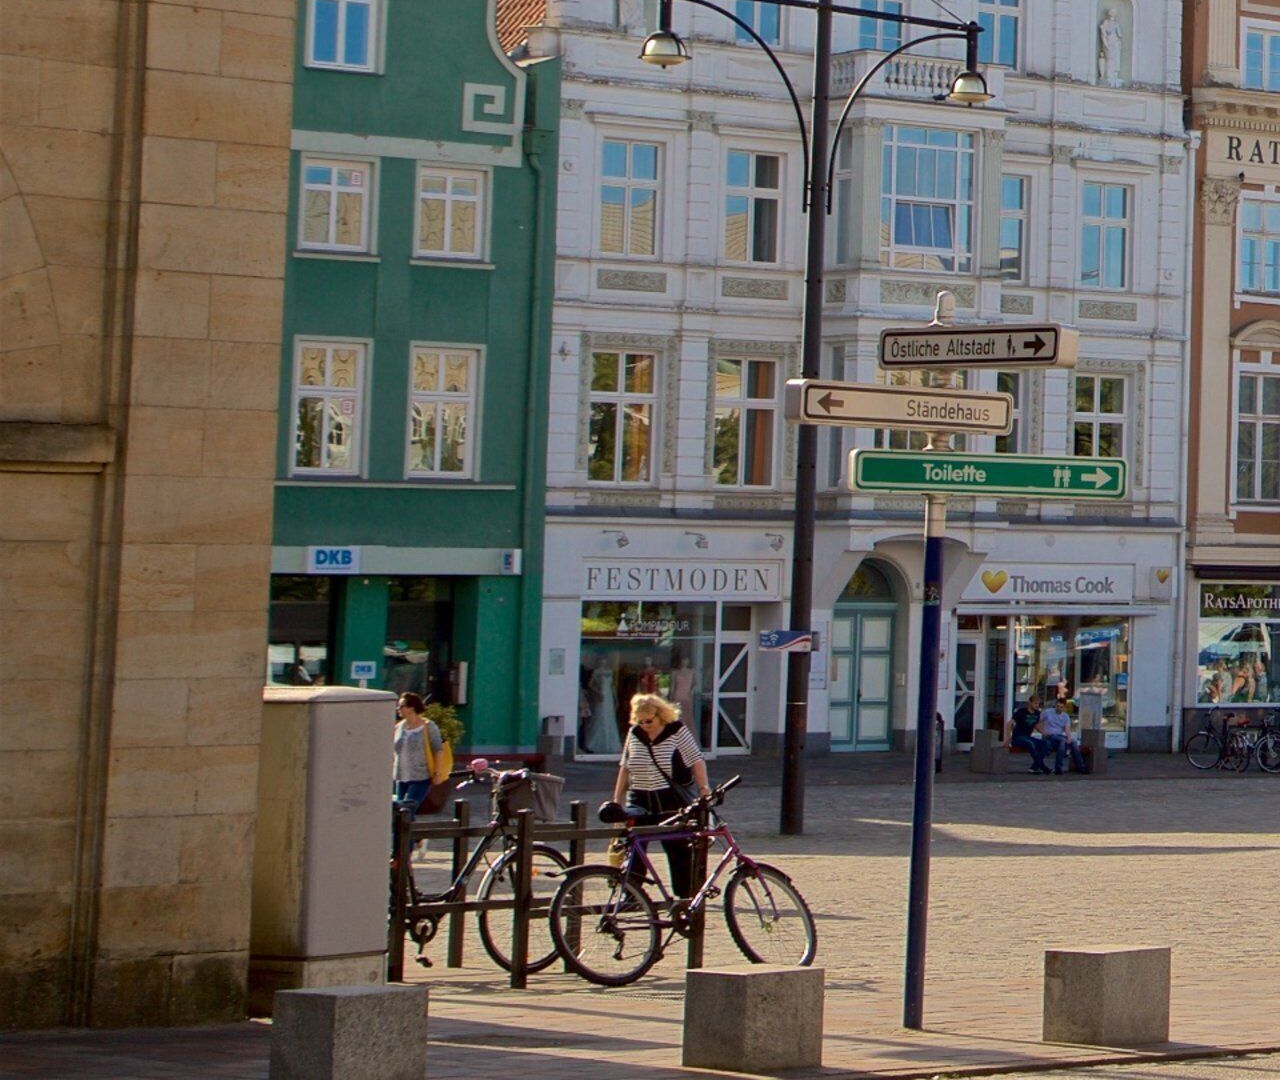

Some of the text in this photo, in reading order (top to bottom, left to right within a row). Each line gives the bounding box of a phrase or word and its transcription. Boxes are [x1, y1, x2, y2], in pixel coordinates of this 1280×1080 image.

[891, 337, 996, 359] Östliche Altstadt
[906, 399, 990, 422] Ständehaus
[922, 463, 987, 483] Toilette
[315, 549, 352, 566] DKB
[587, 566, 770, 592] FESTMODEN
[1010, 575, 1114, 594] Thomas Cook
[354, 664, 374, 674] DKB
